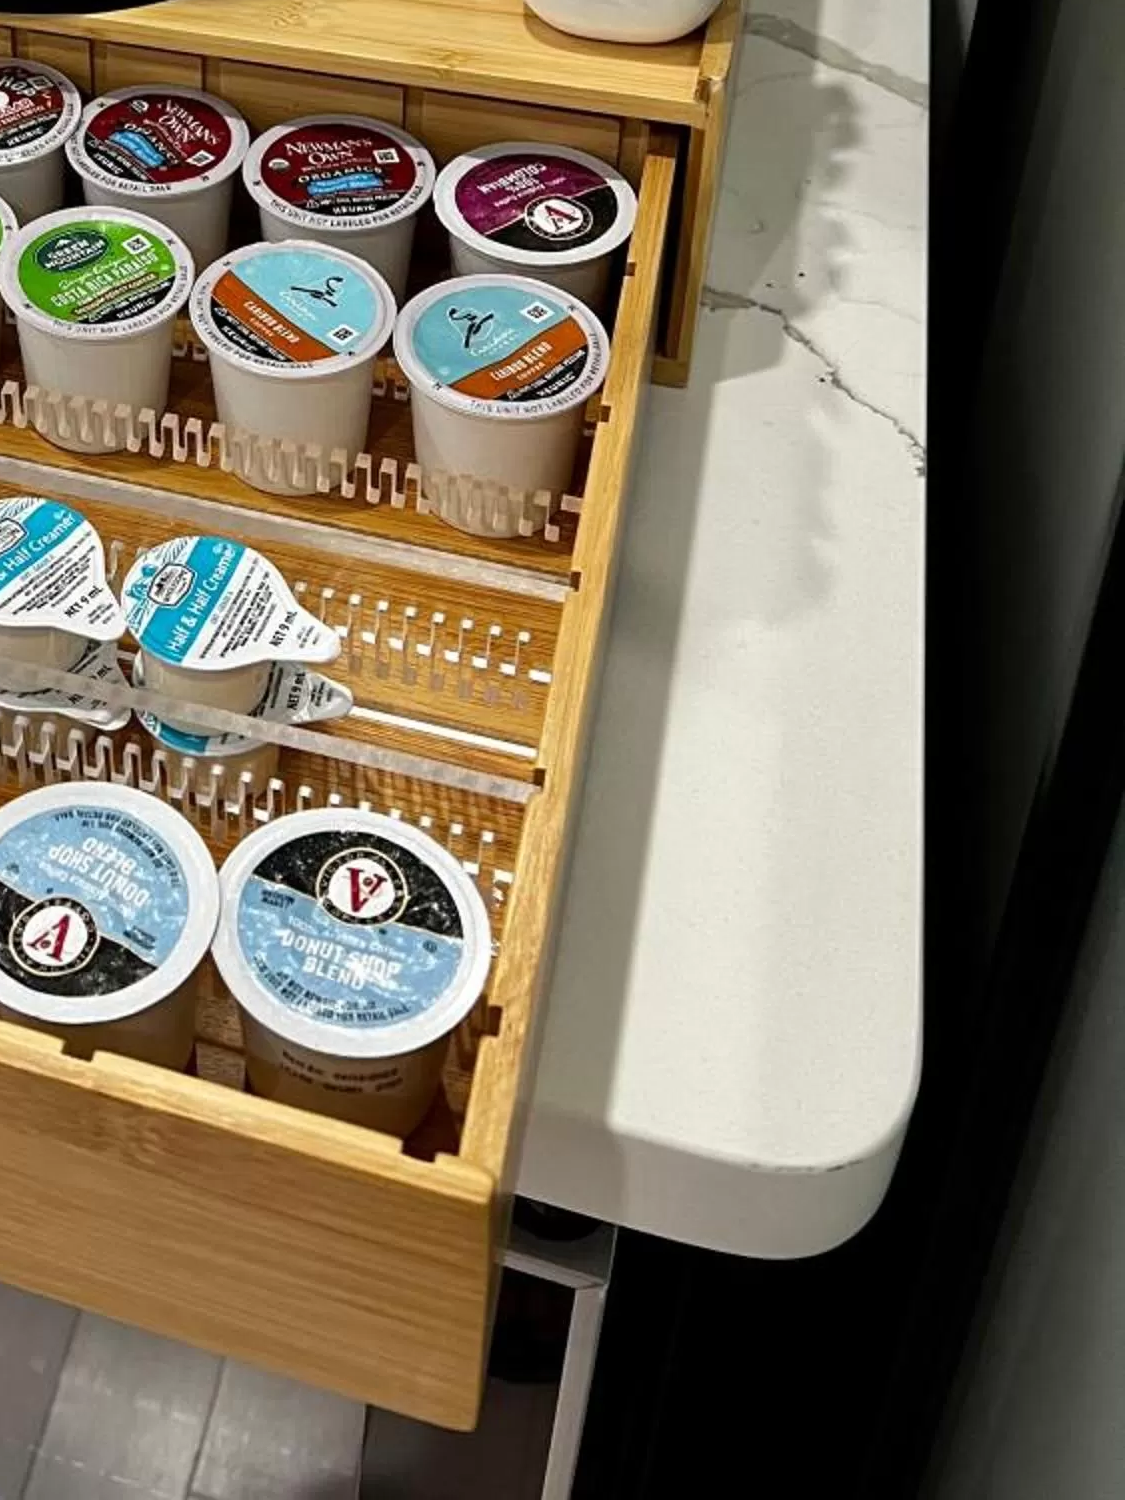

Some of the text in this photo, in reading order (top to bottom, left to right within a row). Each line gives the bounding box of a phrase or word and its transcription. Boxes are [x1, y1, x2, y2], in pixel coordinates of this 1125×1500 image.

[285, 137, 373, 156] NEWMAN'S
[308, 149, 354, 166] OWN
[86, 270, 114, 295] RICA
[525, 340, 554, 365] BLEND
[3, 547, 33, 572] Half
[28, 512, 76, 552] Creamer
[63, 600, 81, 618] NET
[166, 542, 237, 652] Half & Half Creamer
[268, 630, 286, 647] NET
[81, 836, 139, 874] BLEND
[47, 842, 152, 909] DONUT SHOP
[280, 931, 343, 961] DONUT
[303, 958, 365, 990] BLEND
